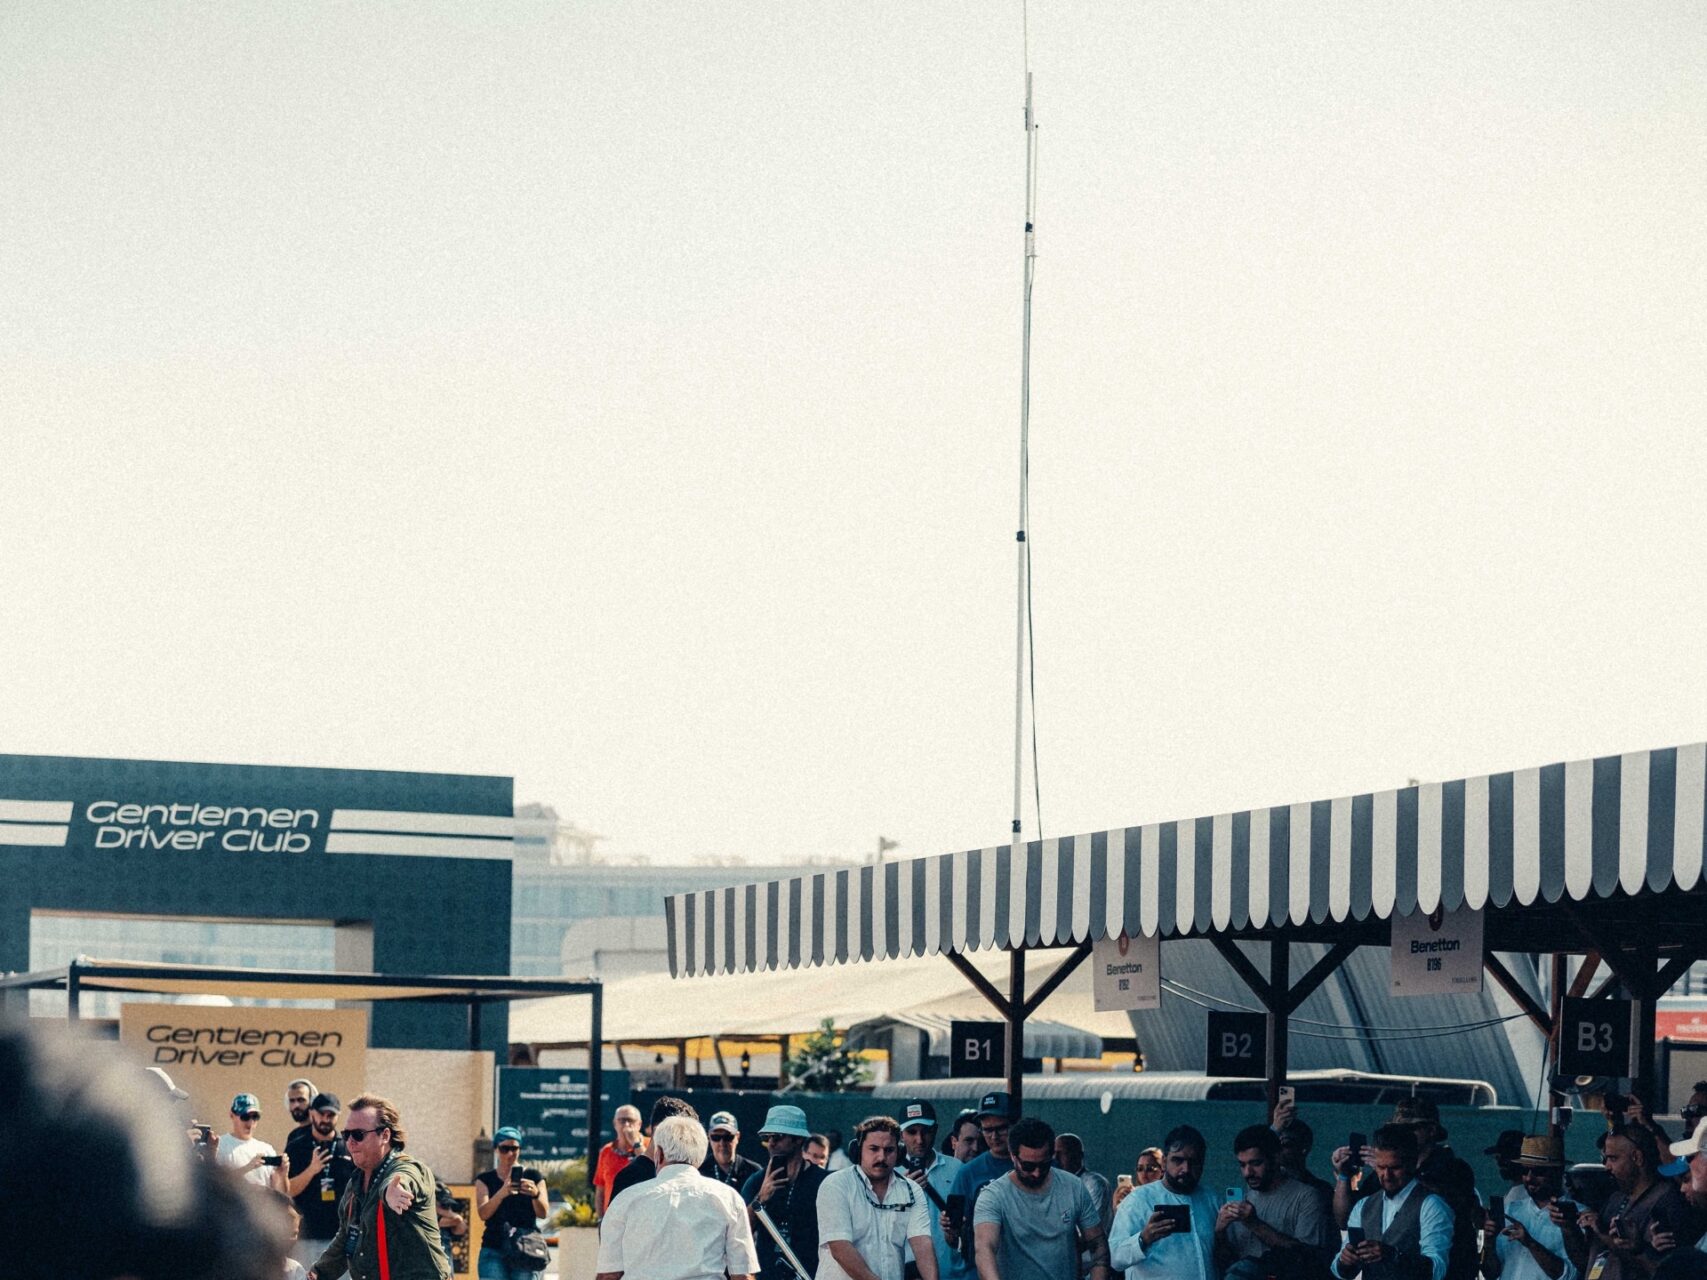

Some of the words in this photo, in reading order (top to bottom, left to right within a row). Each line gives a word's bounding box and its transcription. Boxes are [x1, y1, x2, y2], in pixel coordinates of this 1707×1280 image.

[86, 800, 320, 829] Gentlemen
[95, 824, 215, 851] Driver
[221, 828, 312, 854] Club
[1410, 938, 1460, 954] Benetton
[1106, 962, 1143, 976] Benetton
[146, 1025, 343, 1048] Gentlemen
[1221, 1032, 1253, 1058] B2
[1577, 1021, 1613, 1053] B3
[154, 1045, 255, 1067] Driver
[260, 1048, 336, 1069] Club
[964, 1038, 992, 1061] B1
